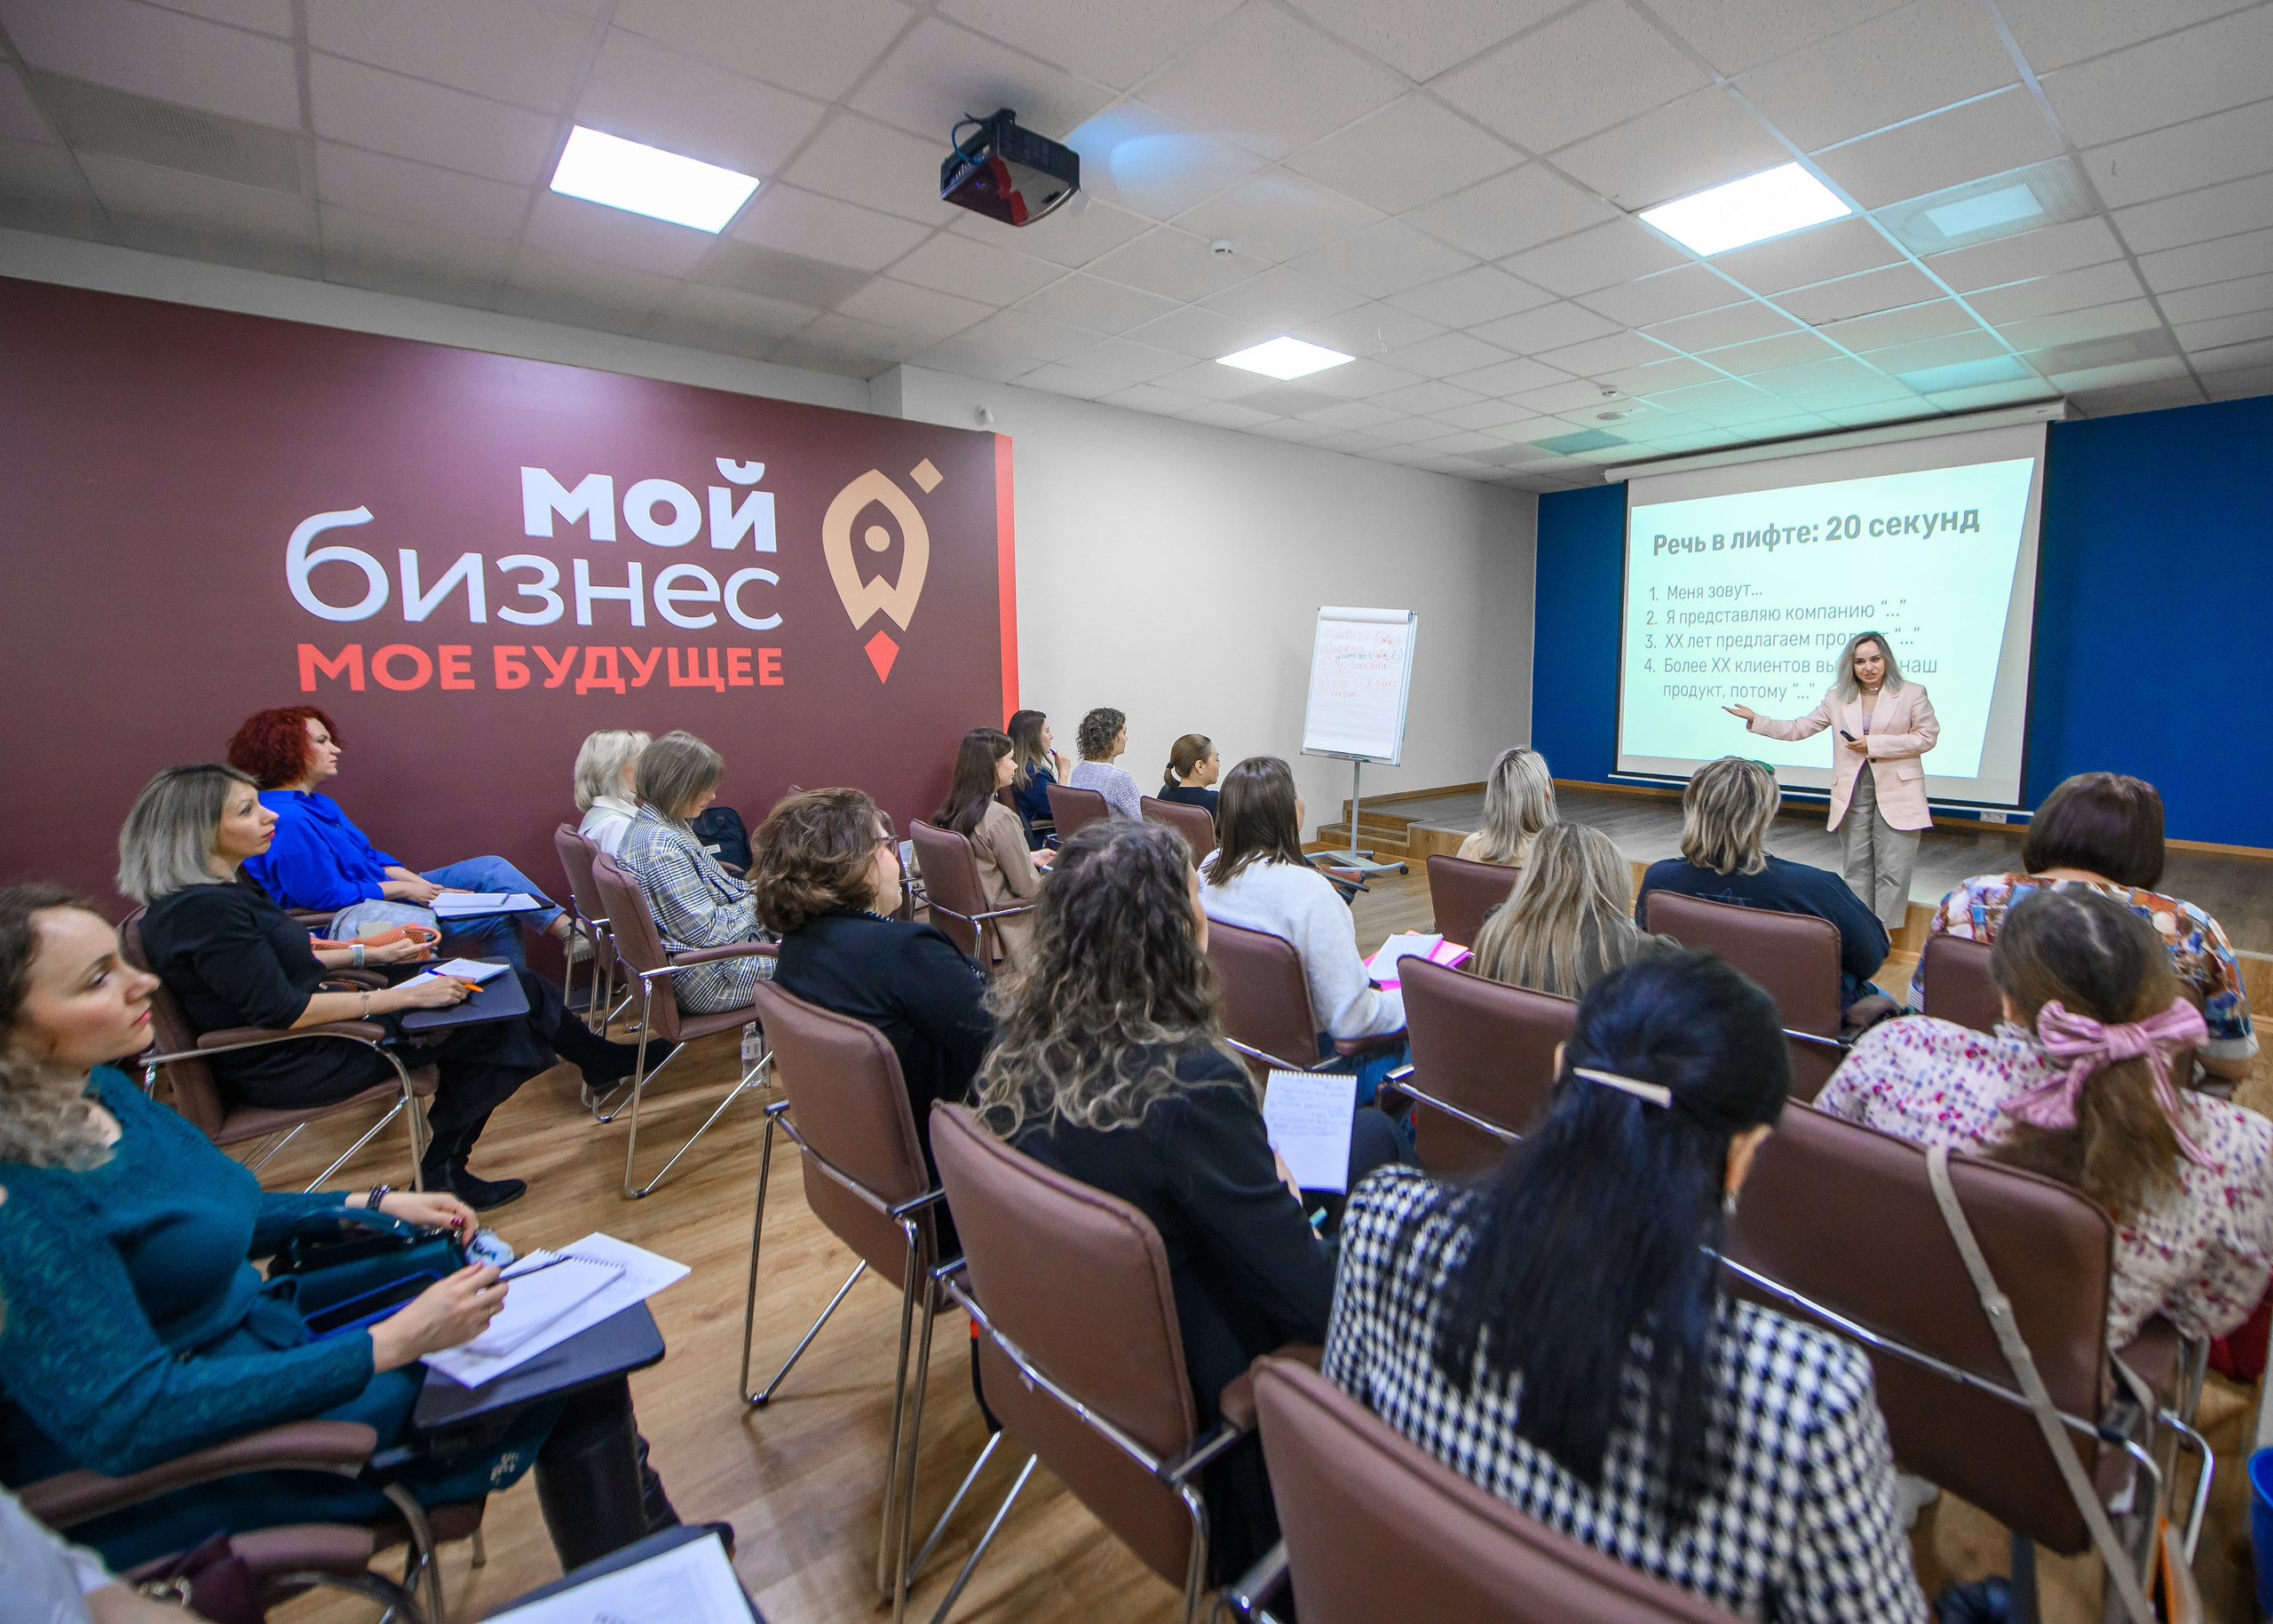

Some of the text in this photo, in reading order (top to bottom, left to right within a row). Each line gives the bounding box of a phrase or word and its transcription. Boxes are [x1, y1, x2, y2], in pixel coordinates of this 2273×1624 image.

[520, 456, 779, 553] мой
[1653, 509, 1980, 556] Речь в лифте: 20 секунд
[285, 504, 784, 631] бизнес
[1649, 583, 1763, 601] 1. Меня зовут...
[1646, 610, 1658, 625] 2.
[1667, 609, 1675, 625] Я
[1679, 608, 1781, 628] представляю
[1786, 604, 1875, 621] компанию
[1644, 634, 1657, 649] 3.
[1687, 636, 1713, 648] лет
[1716, 633, 1810, 651] предлагаем
[296, 643, 785, 695] МОЕ БУДУЩЕЕ
[1643, 658, 1656, 672] 4.
[1664, 657, 1707, 673] Более
[1735, 660, 1810, 673] клиентов
[1900, 659, 1937, 674] наш
[1663, 685, 1726, 701] продукт,
[1730, 685, 1788, 703] потому
